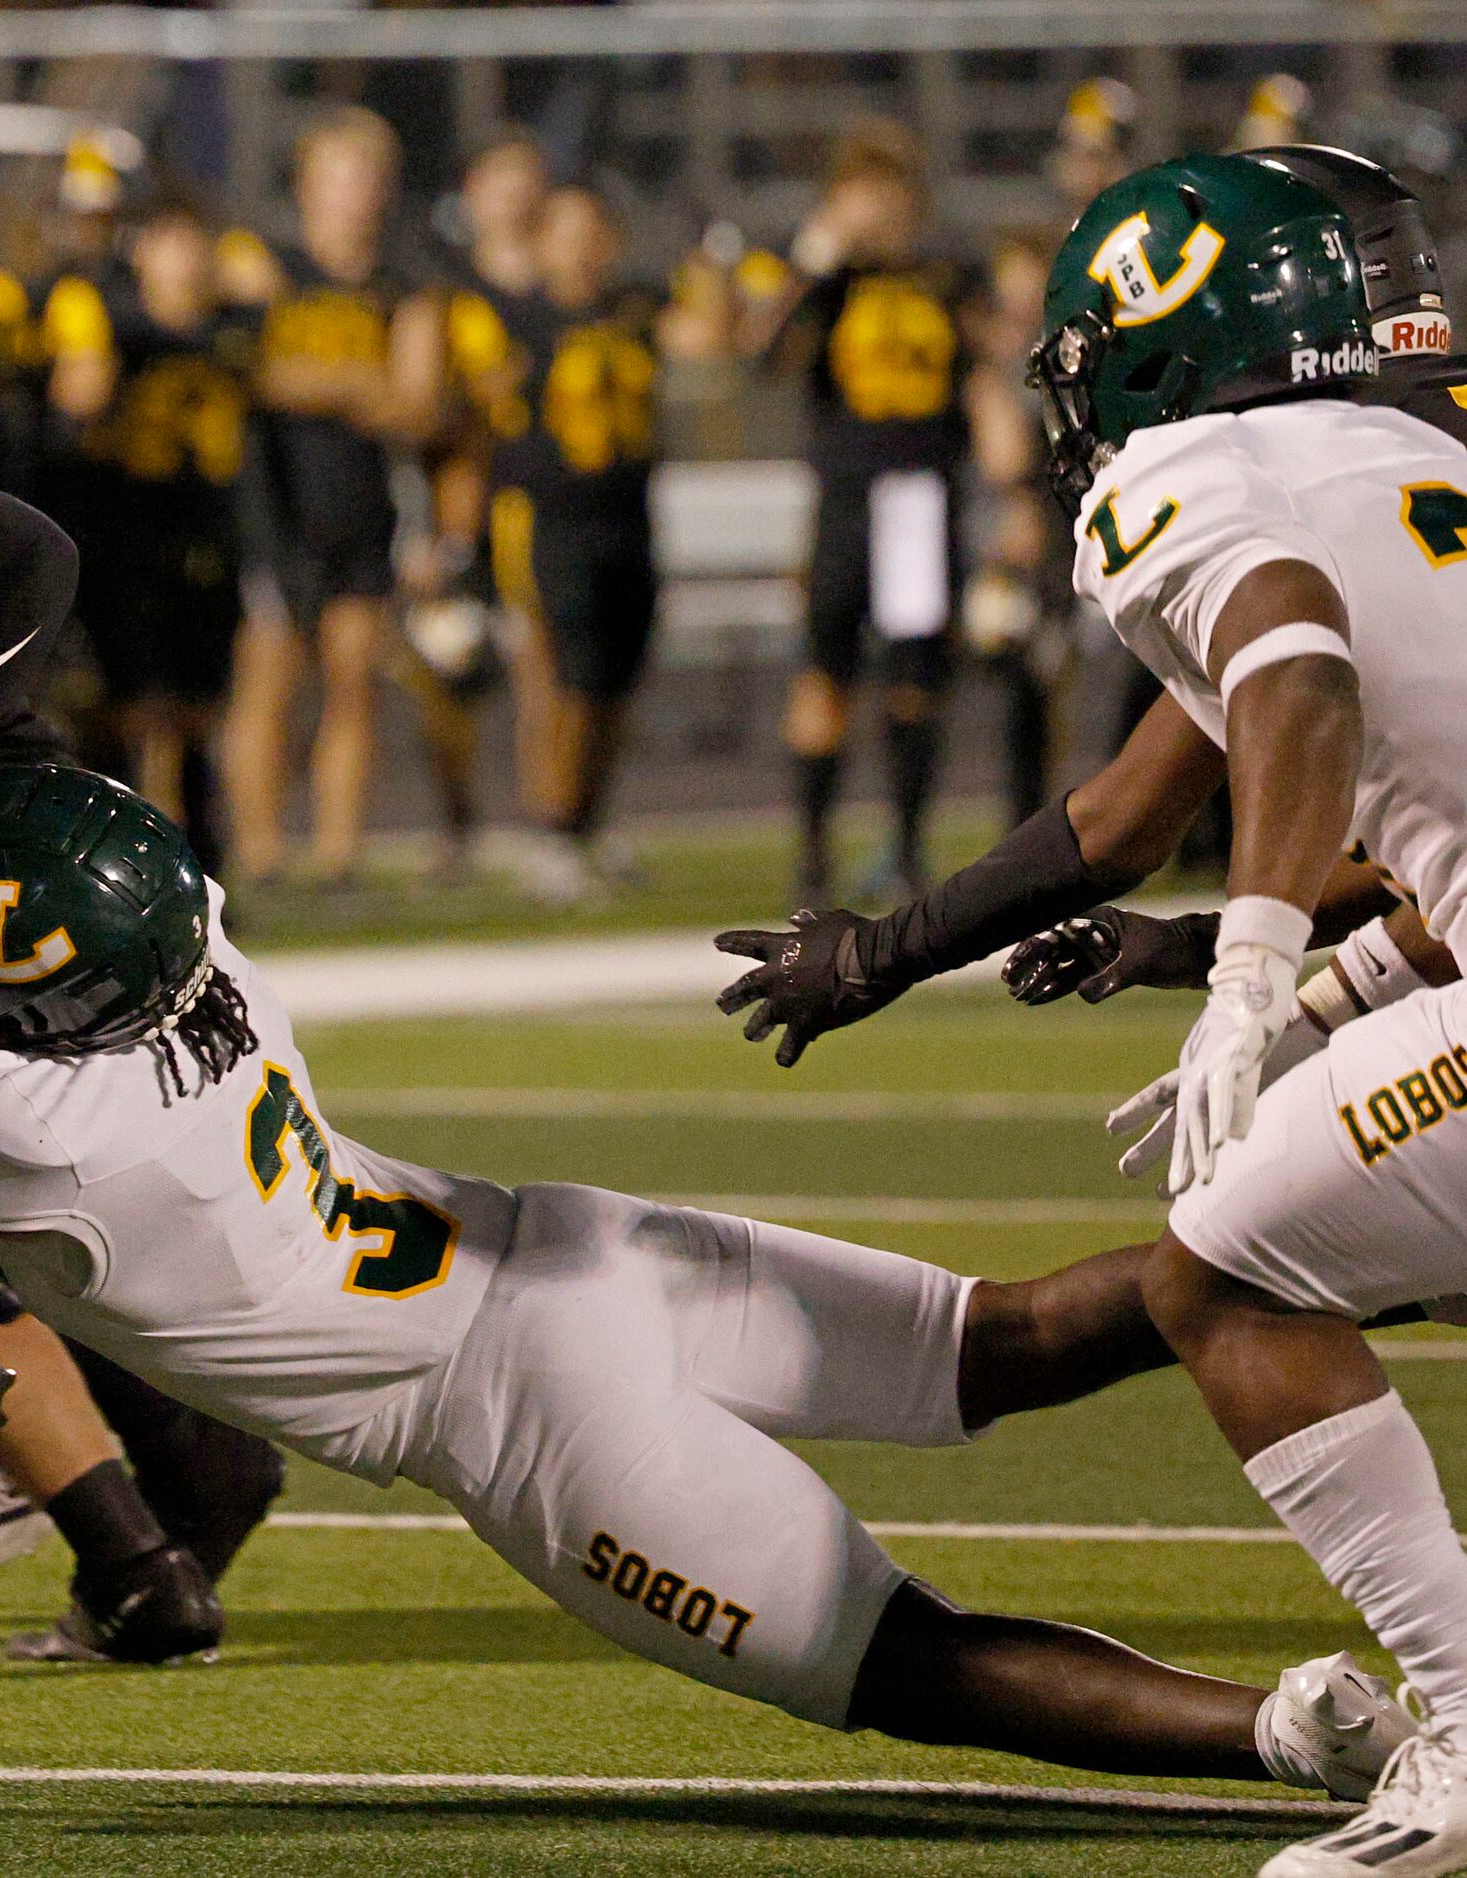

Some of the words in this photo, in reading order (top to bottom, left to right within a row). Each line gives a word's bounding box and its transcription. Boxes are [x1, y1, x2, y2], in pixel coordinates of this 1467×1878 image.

[1087, 210, 1227, 328] L
[1321, 229, 1346, 260] 31
[1290, 341, 1380, 383] Riddel
[1086, 486, 1182, 579] L
[244, 1059, 464, 1300] 3
[582, 1530, 757, 1659] LOBOS
